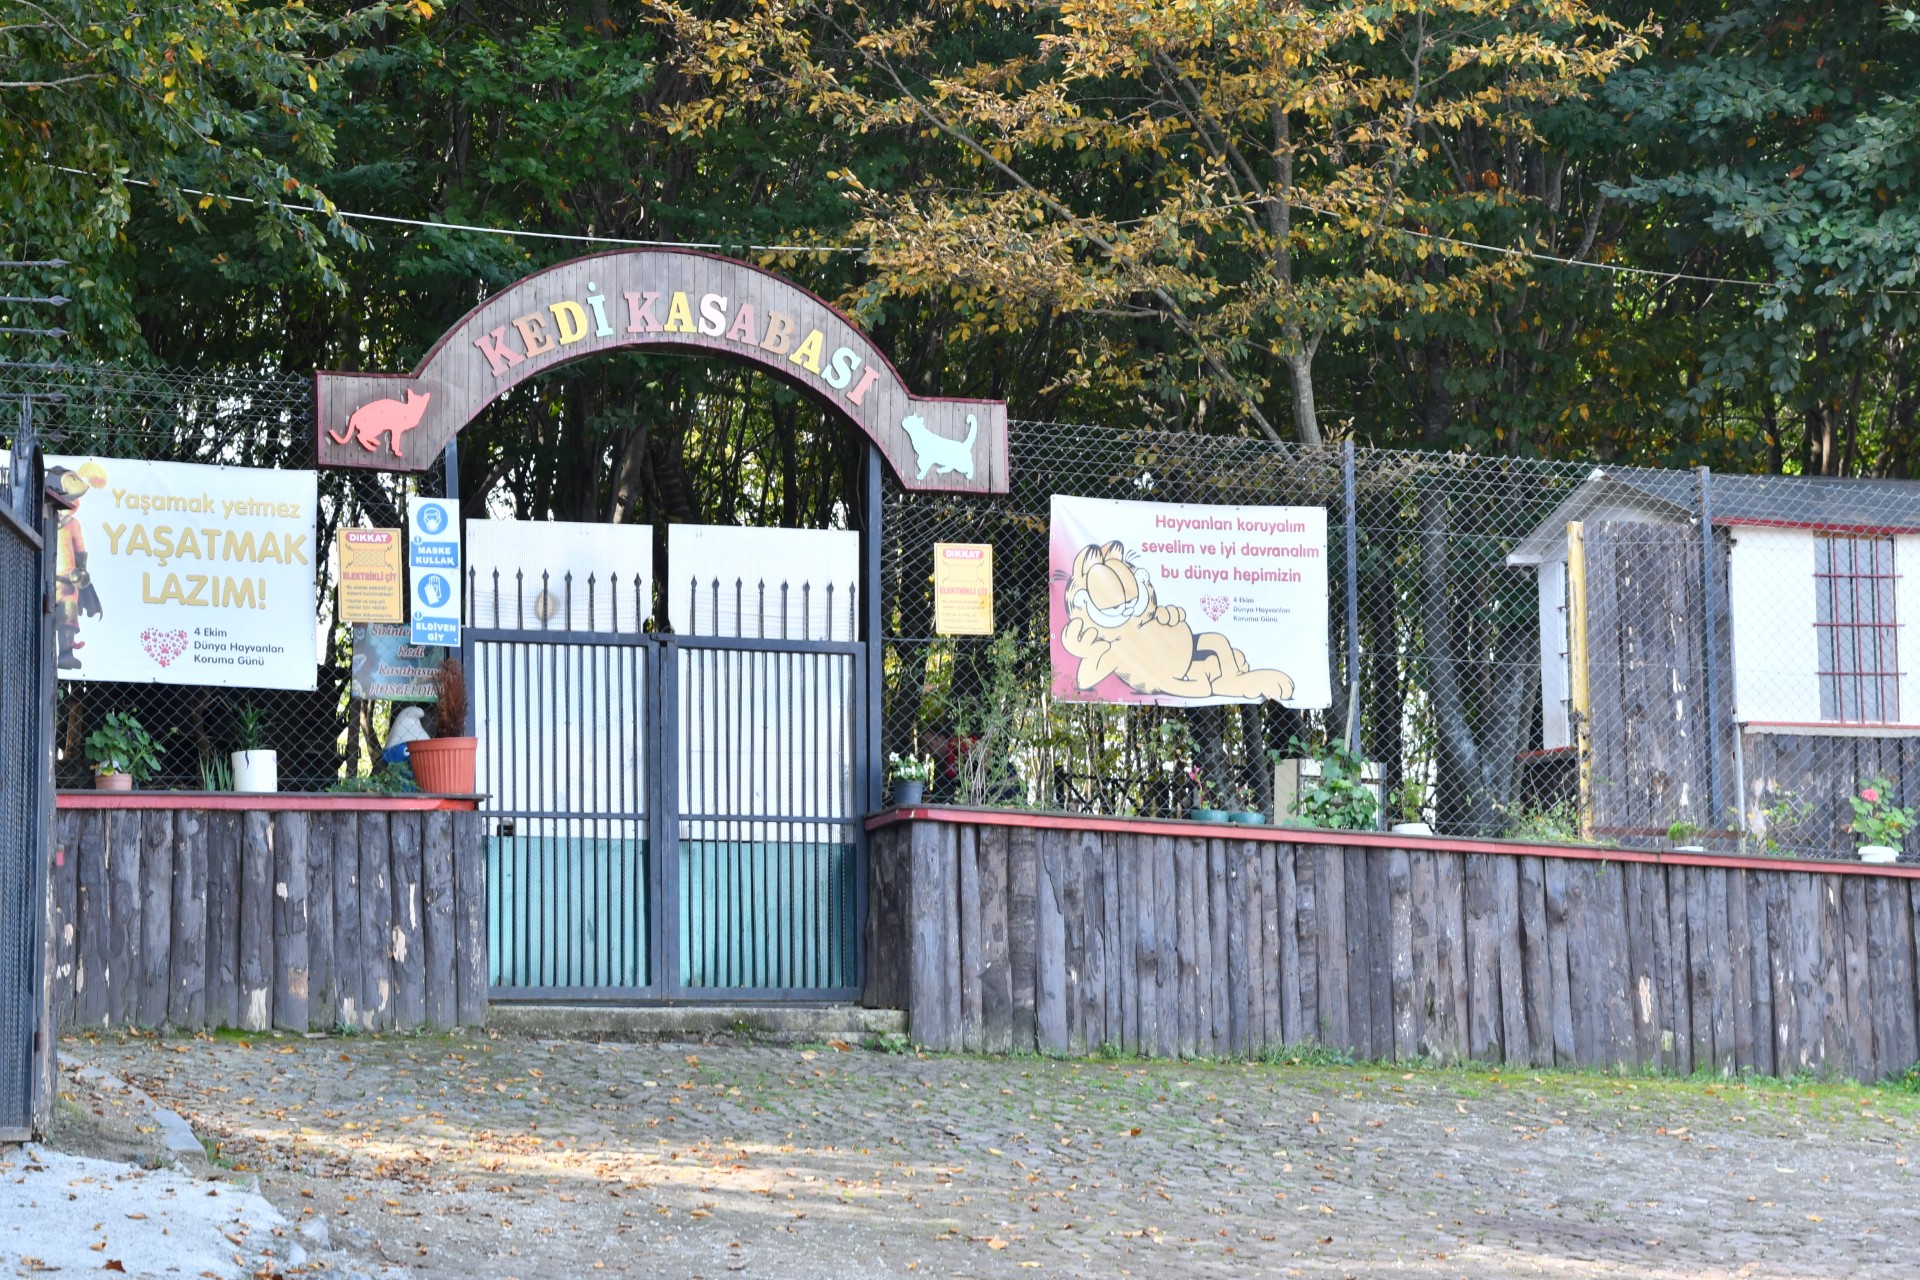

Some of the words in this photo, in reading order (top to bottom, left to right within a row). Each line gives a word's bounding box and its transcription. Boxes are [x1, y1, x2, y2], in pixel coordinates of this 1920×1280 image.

[473, 281, 614, 378] KEDİ
[623, 290, 881, 407] KASABASI
[112, 488, 215, 515] Yaşamak
[222, 497, 301, 519] yetmez
[1155, 514, 1233, 532] Hayvanları
[1237, 517, 1305, 535] koruyalım
[102, 522, 308, 566] YAŞATMAK
[418, 546, 451, 555] MASKE
[1141, 540, 1195, 554] sevelim
[1199, 544, 1216, 555] ve
[1220, 541, 1236, 559] iyi
[1241, 542, 1320, 558] davranalım
[416, 556, 453, 565] KULLAN
[1161, 564, 1179, 579] bu
[1184, 565, 1229, 584] dünya
[1234, 567, 1302, 585] hepimizin
[142, 571, 266, 610] LAZIM!
[1233, 606, 1254, 614] Dünya
[1255, 606, 1291, 614] Hayvanları
[194, 627, 201, 636] 4
[204, 627, 227, 638] Ekim
[416, 622, 456, 632] ELDİVEN
[427, 632, 444, 641] GİY
[194, 640, 227, 653] Dünya
[230, 642, 284, 654] Hayvanları
[397, 645, 426, 657] Kedi
[194, 654, 234, 665] Koruma
[237, 656, 264, 666] Günü
